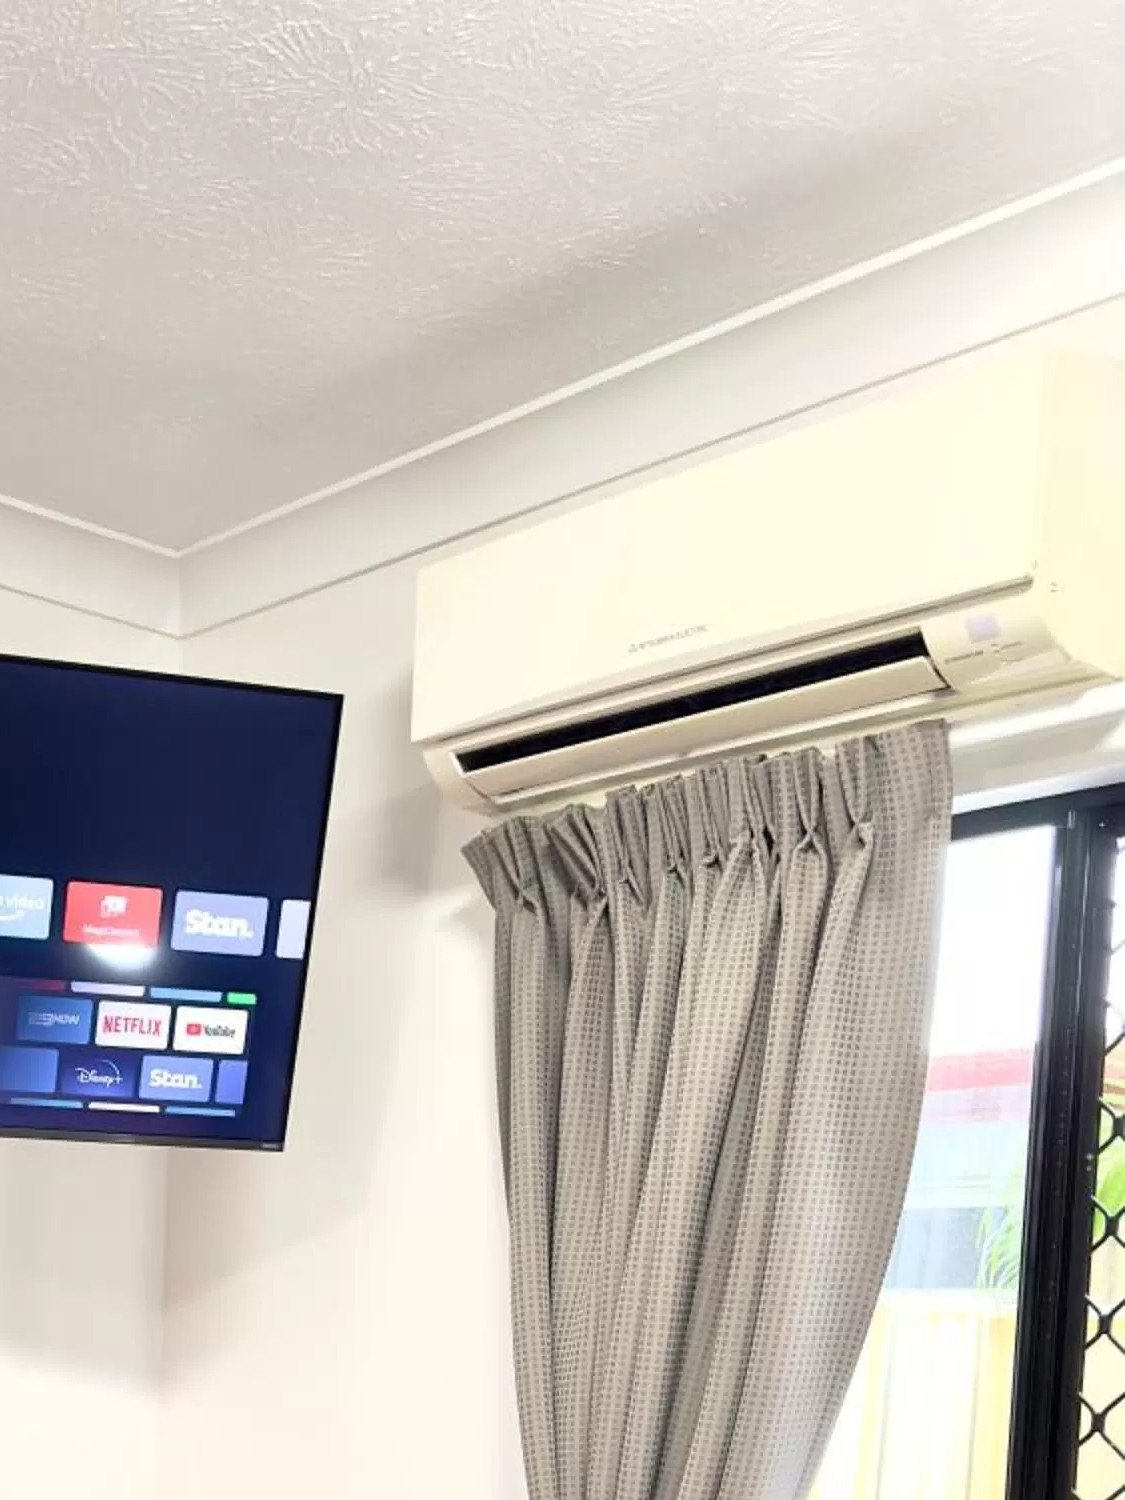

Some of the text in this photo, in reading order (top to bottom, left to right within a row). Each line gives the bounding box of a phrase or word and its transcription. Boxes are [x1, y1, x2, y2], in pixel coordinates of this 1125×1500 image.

[6, 892, 44, 911] video
[102, 1014, 163, 1037] NETFLIX
[202, 1023, 236, 1039] YouTube
